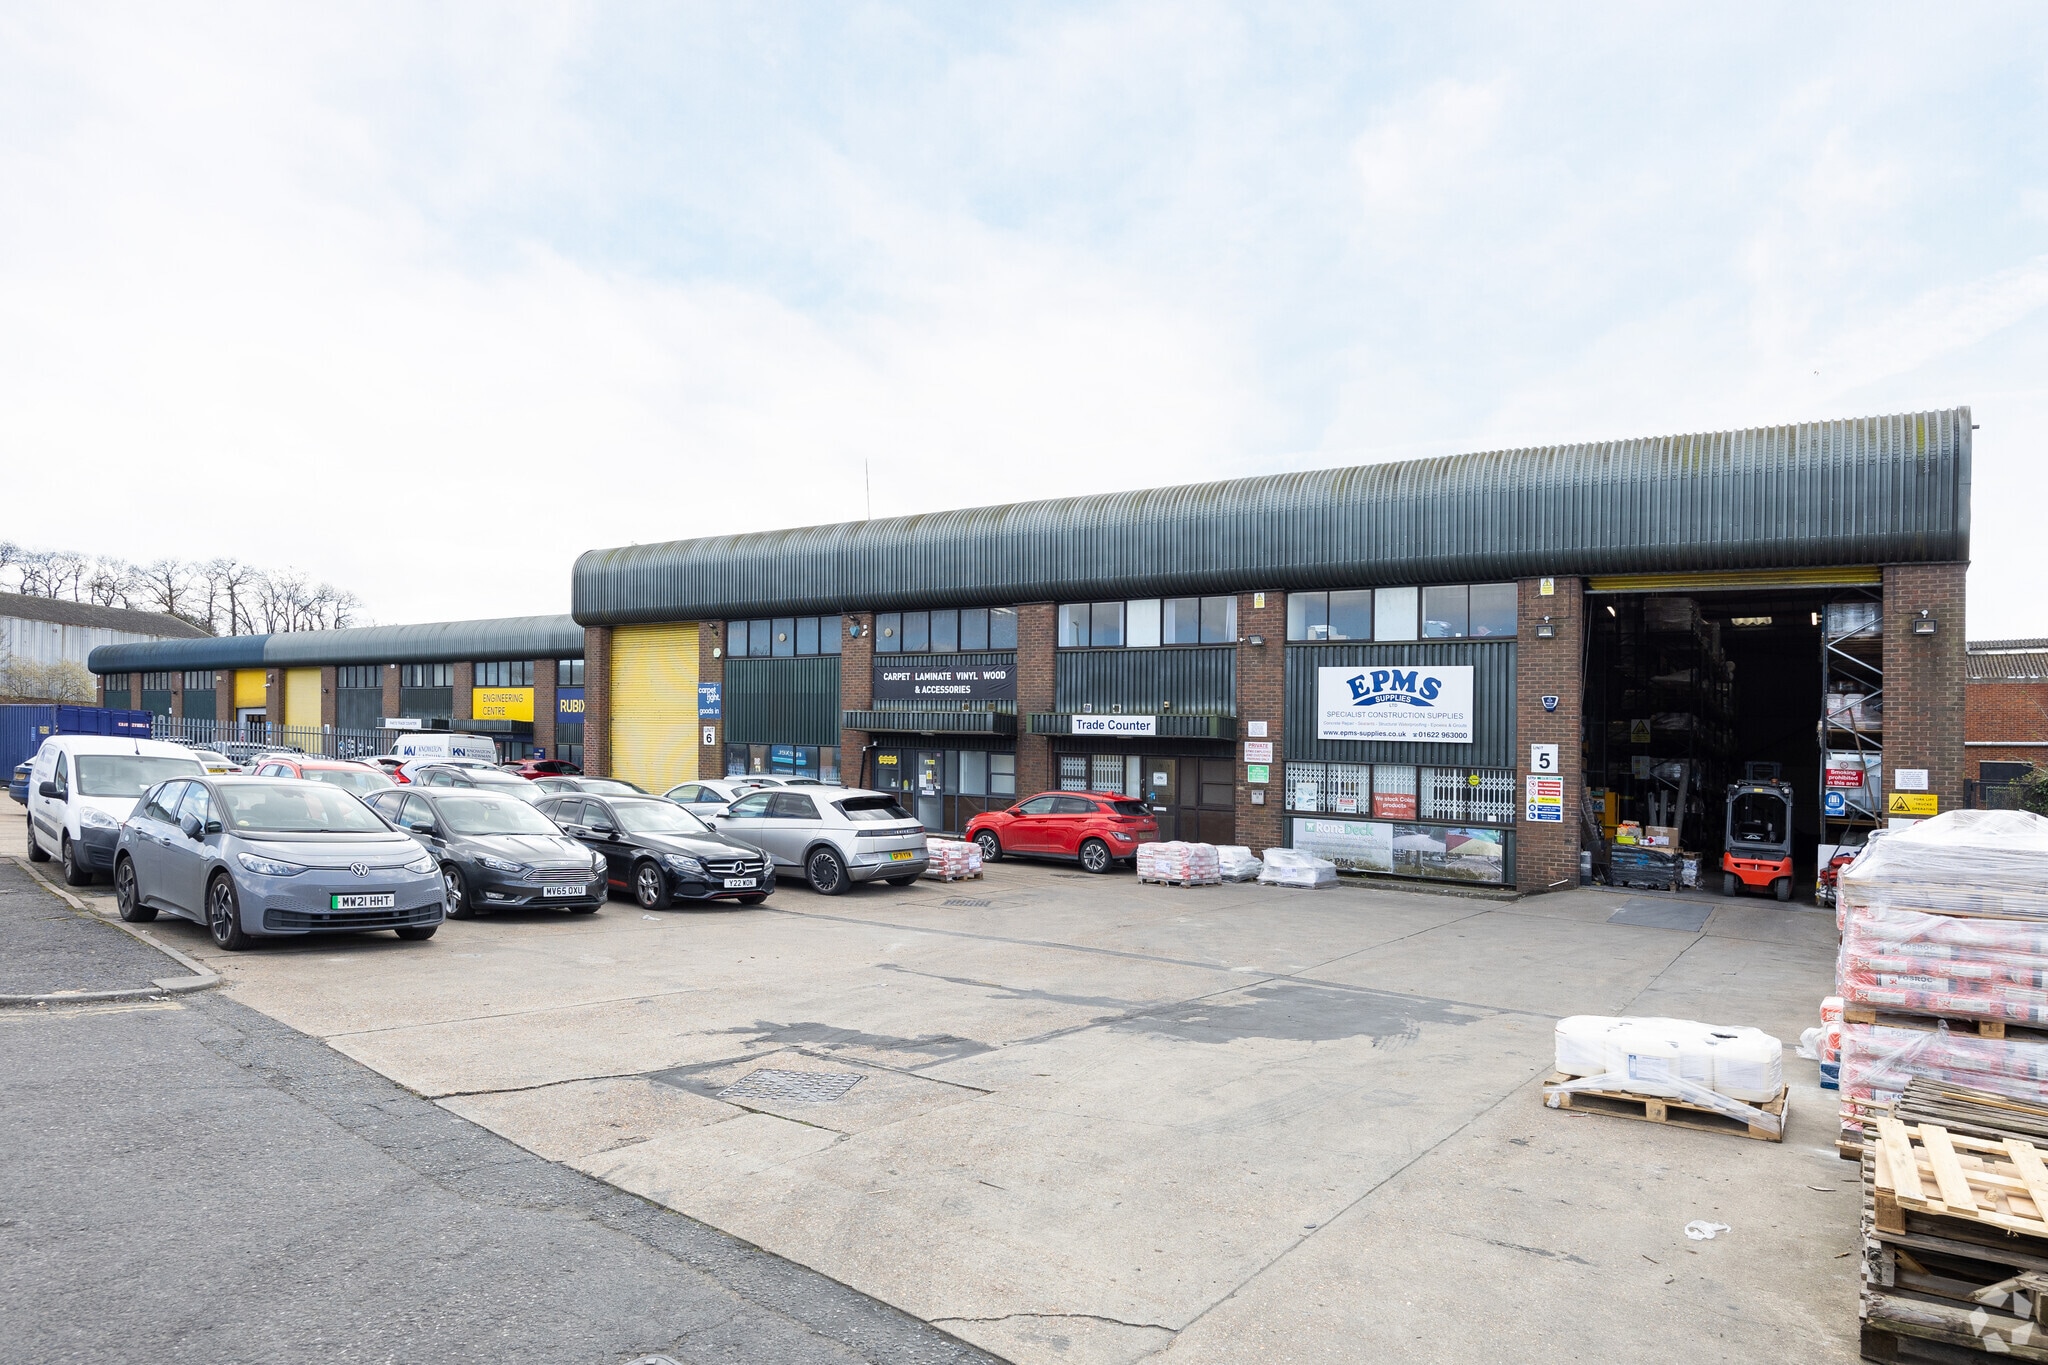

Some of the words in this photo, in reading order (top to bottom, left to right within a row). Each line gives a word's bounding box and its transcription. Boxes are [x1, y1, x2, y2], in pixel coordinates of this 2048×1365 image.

[915, 672, 951, 680] LAMINATE
[956, 672, 978, 680] VINYL
[983, 671, 1006, 680] WOOD
[1346, 670, 1442, 700] EPMS
[698, 687, 716, 696] carpet
[915, 686, 920, 694] &
[922, 686, 971, 694] ACCESSORIES
[482, 694, 523, 702] ENGINEERING
[482, 706, 506, 715] CENTRE
[1076, 720, 1104, 729] Trade
[1108, 720, 1150, 730] Counter
[706, 734, 712, 743] 6
[453, 748, 465, 756] KN
[1539, 753, 1550, 769] 5
[1316, 822, 1373, 836] RonaDeck
[1328, 857, 1356, 868] PMS
[547, 887, 566, 895] MV65
[342, 897, 367, 906] MW21
[370, 896, 390, 906] HHT
[1898, 975, 1933, 983] FOSROC
